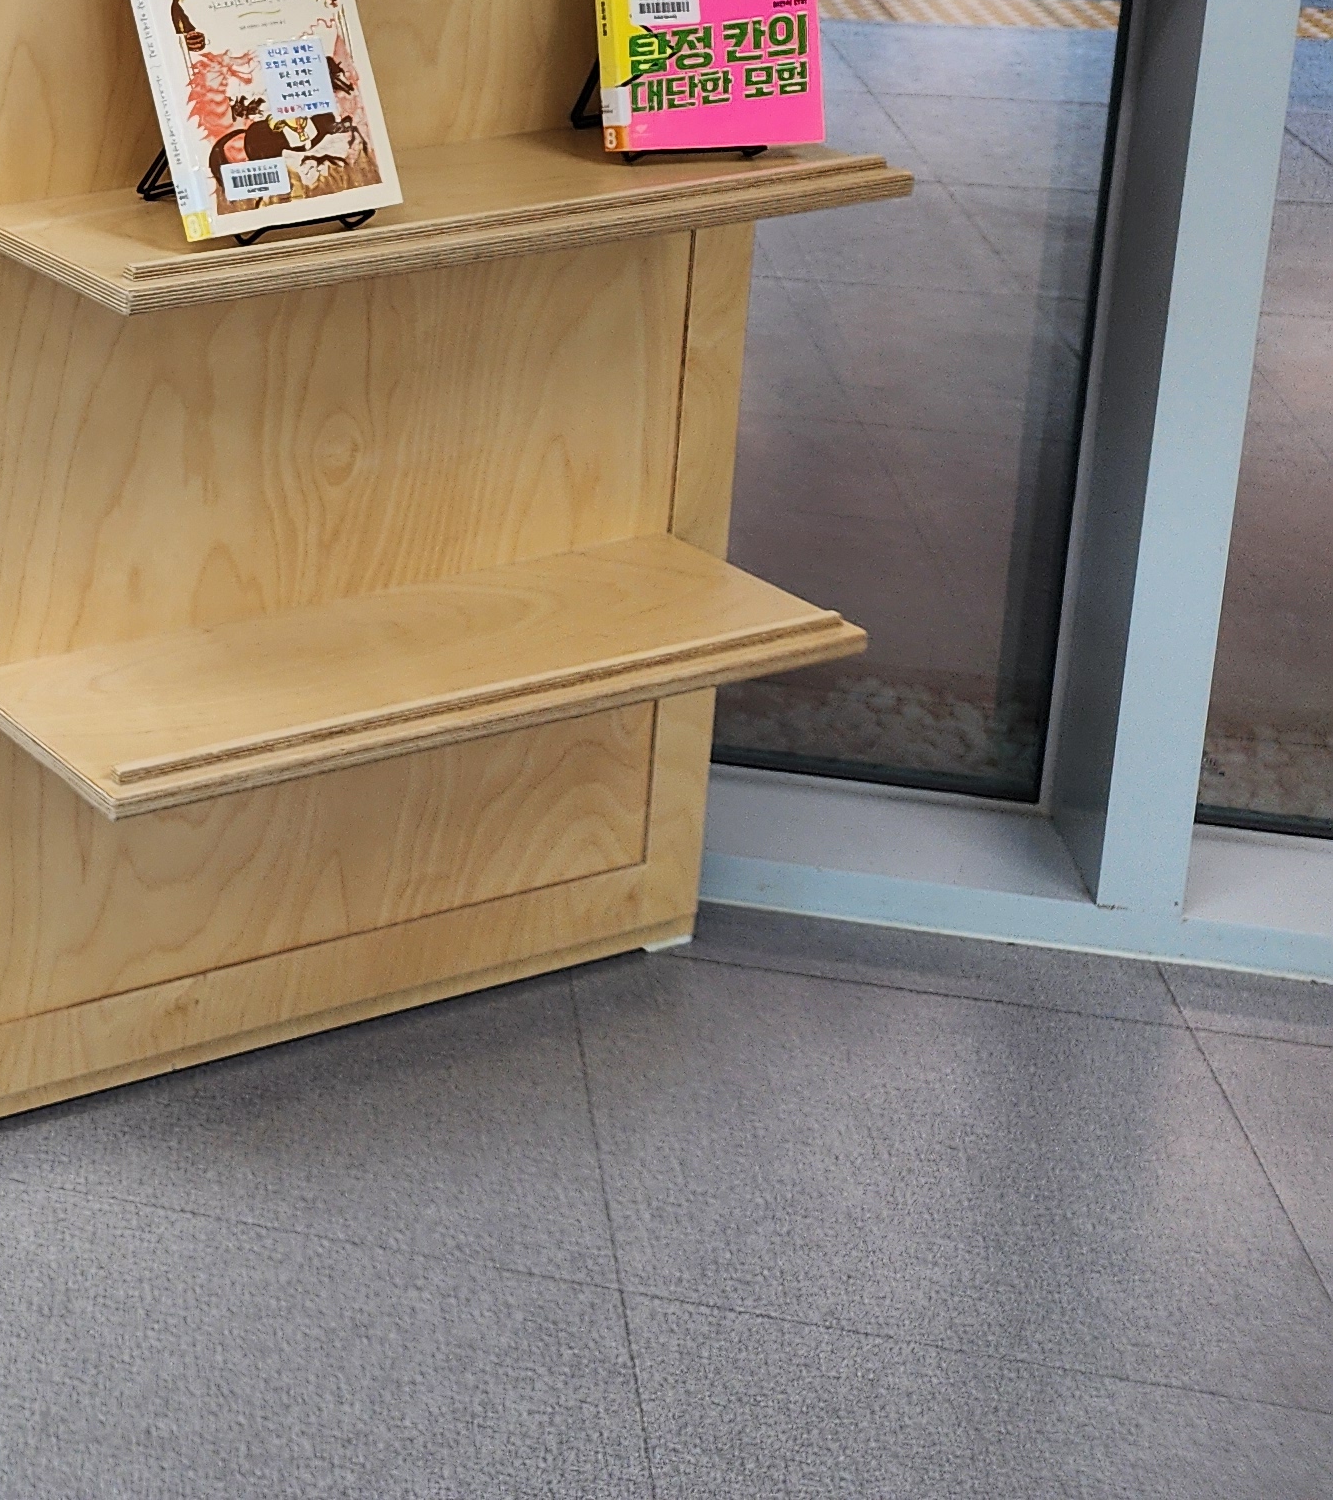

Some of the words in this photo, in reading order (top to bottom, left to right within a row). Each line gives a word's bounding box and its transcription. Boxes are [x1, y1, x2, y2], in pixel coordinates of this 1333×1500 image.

[629, 24, 713, 74] 탐정
[722, 12, 808, 63] 칸의
[631, 69, 733, 113] 대단한
[744, 59, 808, 99] 모험
